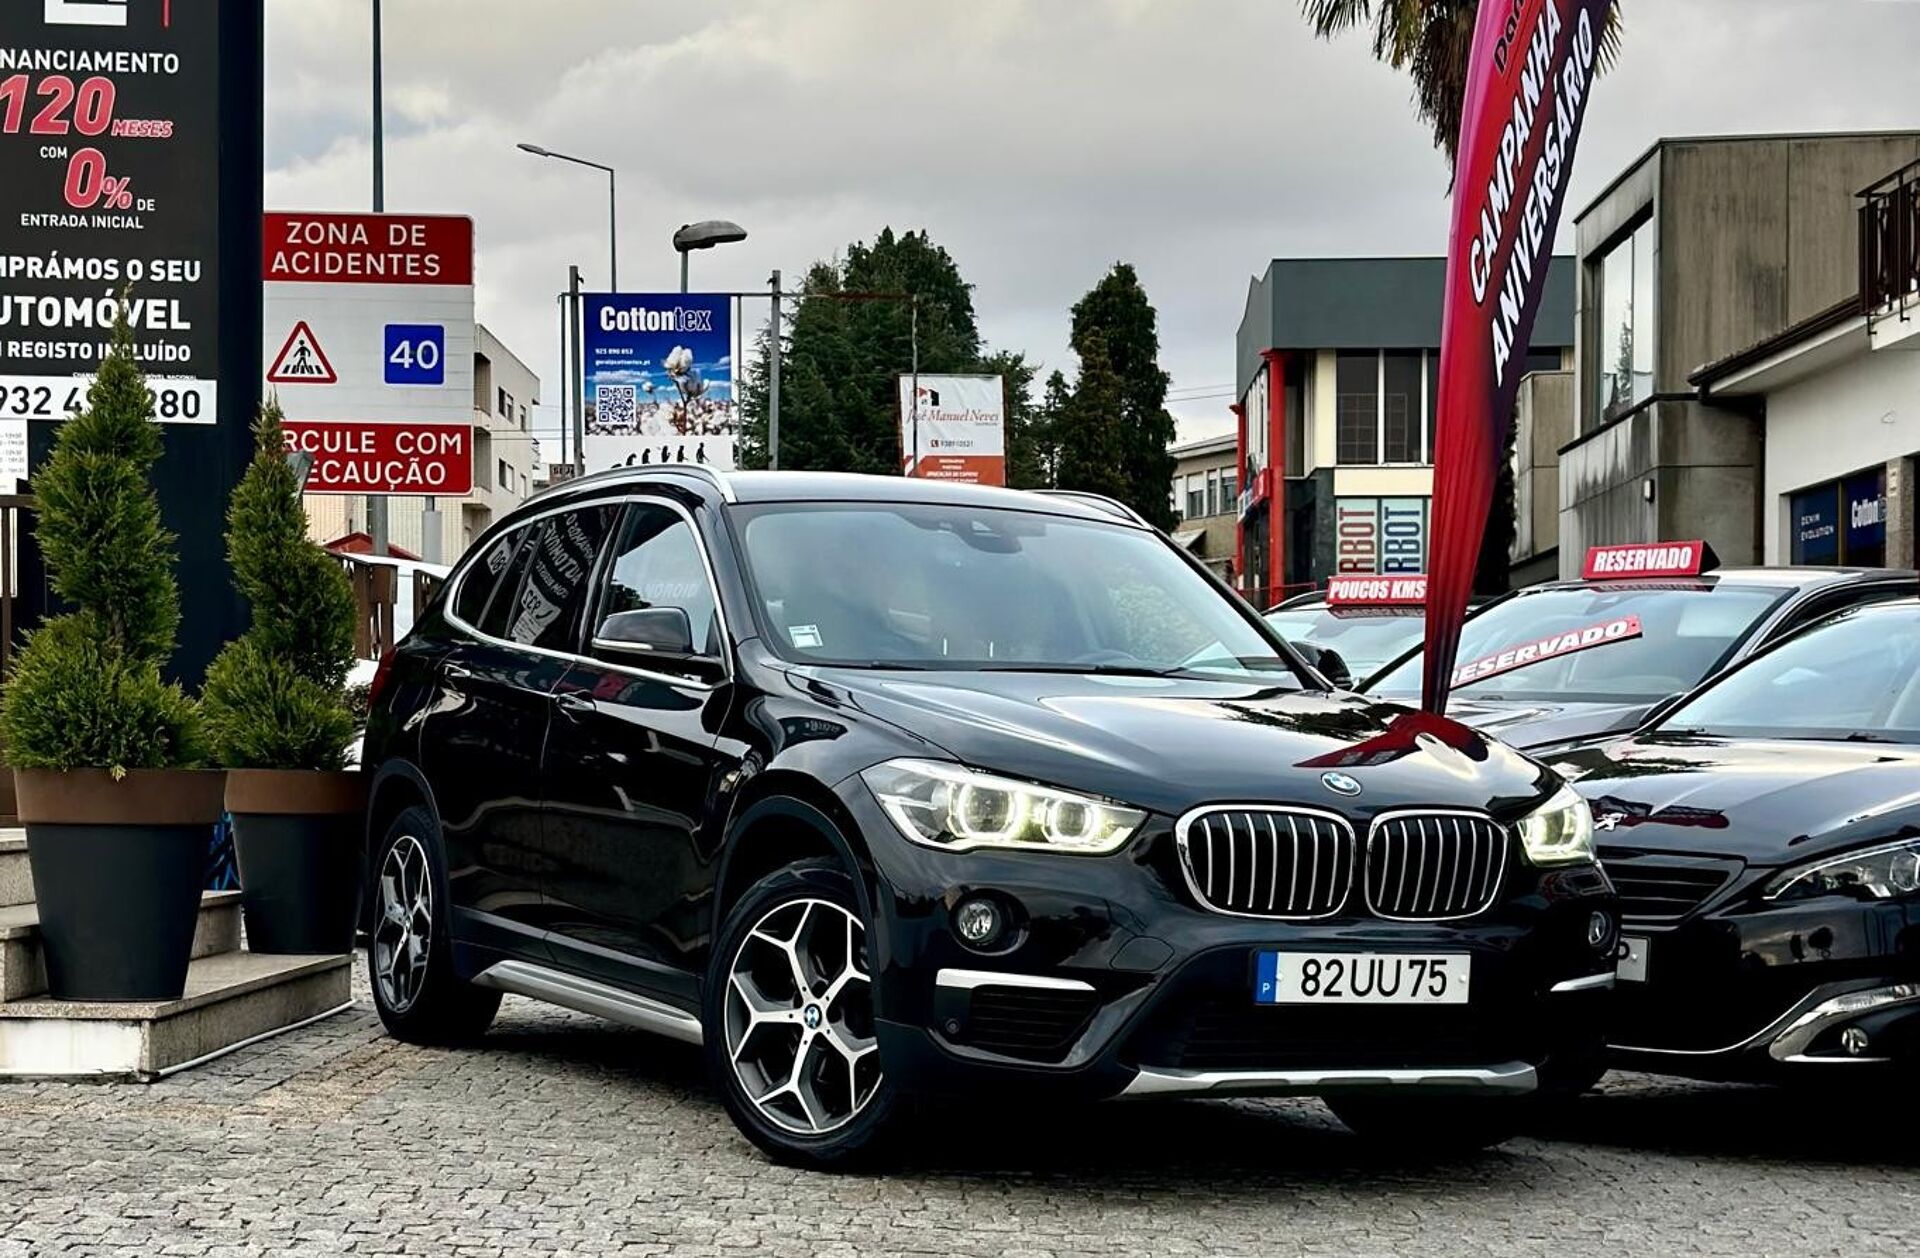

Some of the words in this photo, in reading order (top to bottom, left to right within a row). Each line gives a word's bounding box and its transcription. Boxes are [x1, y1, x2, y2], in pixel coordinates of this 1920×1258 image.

[0, 49, 180, 74] NANCIAMENTO
[0, 74, 116, 136] 120
[111, 119, 174, 137] MESES
[1470, 0, 1561, 303] CAMPANHA
[40, 146, 68, 159] COM
[64, 147, 133, 210] 0%
[137, 199, 156, 211] DE
[1491, 7, 1592, 388] ANIVERSÁRIO
[20, 213, 88, 228] ENTRADA
[91, 215, 144, 229] INICIAL
[286, 221, 369, 245] ZONA
[388, 224, 426, 246] DE
[0, 250, 119, 281] PRÁMOS
[126, 258, 143, 281] O
[150, 259, 201, 282] SEU
[271, 251, 441, 276] ACIDENTES
[600, 306, 711, 332] Cottontex
[8, 340, 92, 360] REGISTO
[389, 340, 439, 370] 40
[906, 409, 927, 424] Jsé
[928, 409, 968, 422] Manuel
[395, 432, 462, 455] COM
[1593, 546, 1692, 572] RESERVADO
[1329, 580, 1389, 599] POUCOS
[1390, 580, 1427, 599] KMS
[1451, 620, 1628, 688] ESERVADO
